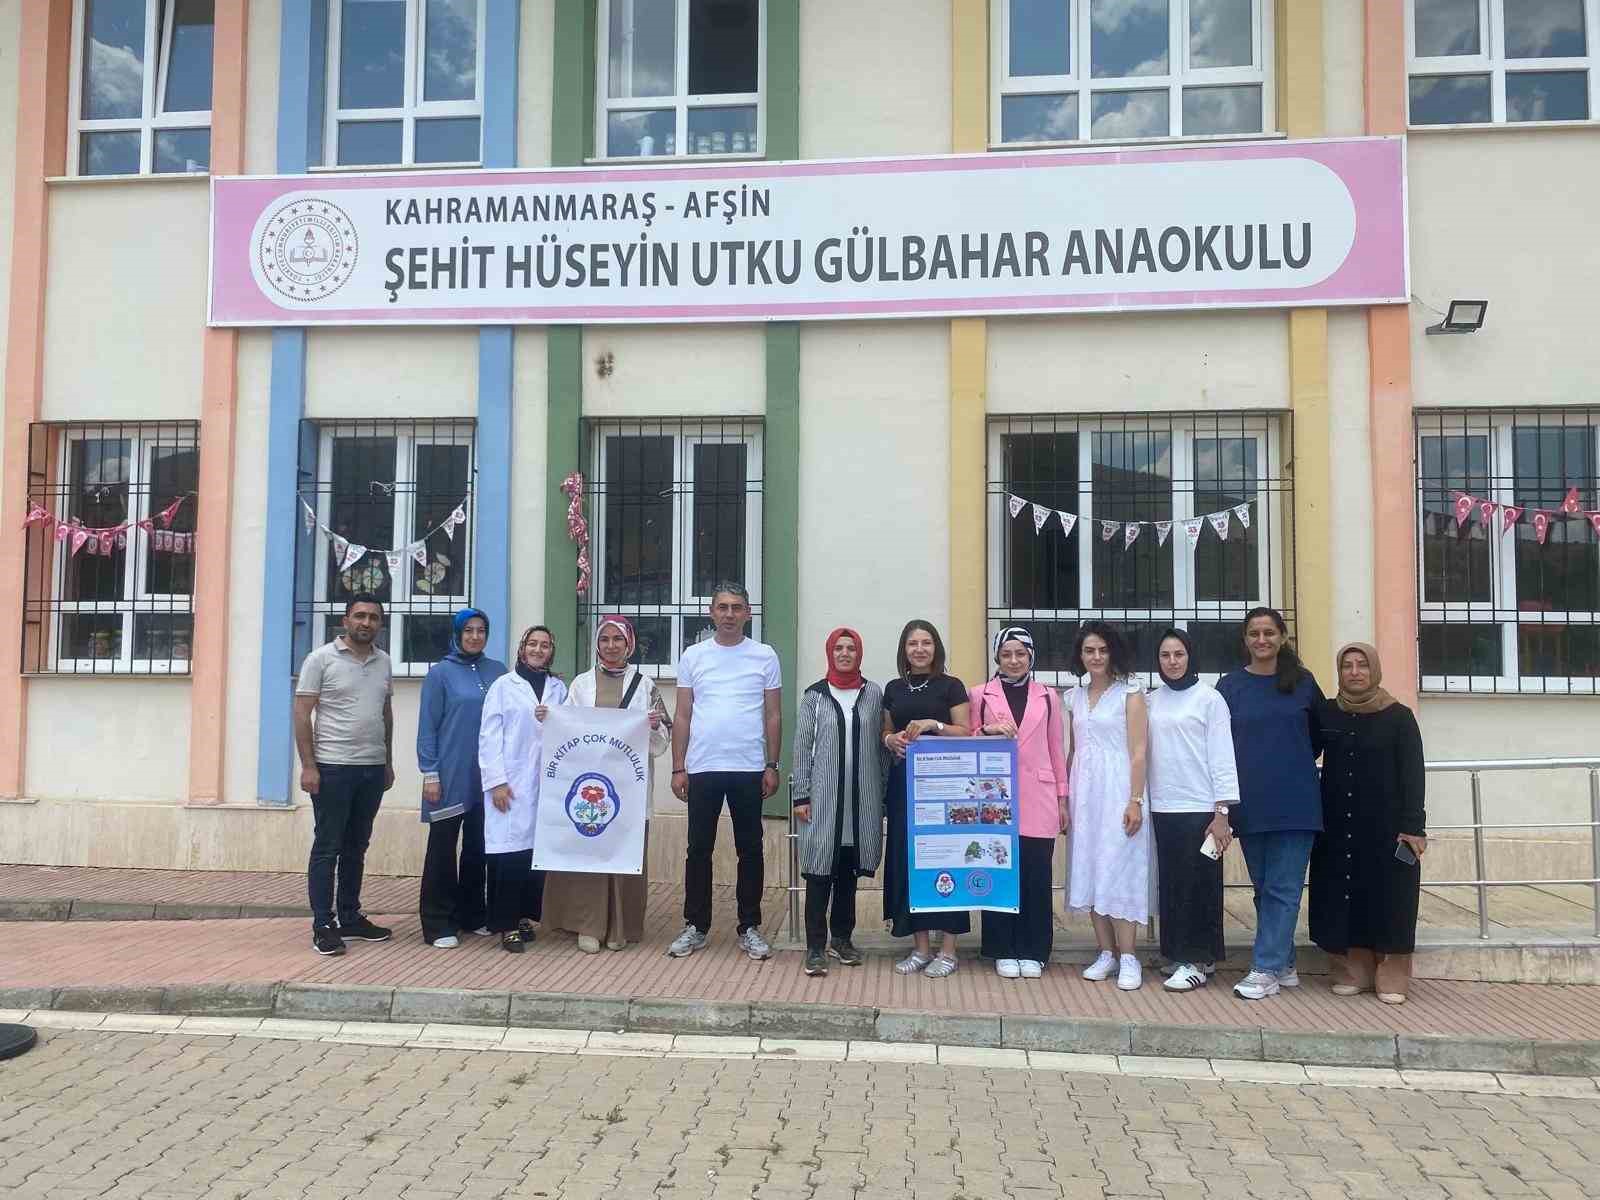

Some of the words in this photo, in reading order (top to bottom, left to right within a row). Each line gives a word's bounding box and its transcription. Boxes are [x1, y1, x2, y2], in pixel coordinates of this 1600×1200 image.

[386, 193, 656, 226] KAHRAMANMARAŞ
[683, 184, 770, 225] AFŞİN
[385, 236, 495, 303] ŞEHİT
[506, 232, 678, 288] HÜSEYİN
[692, 239, 801, 286] UTKU
[814, 226, 1050, 283] GÜLBAHAR
[1062, 223, 1312, 275] ANAOKULU
[583, 734, 607, 744] ÇOK
[609, 737, 644, 782] MUTLULUK
